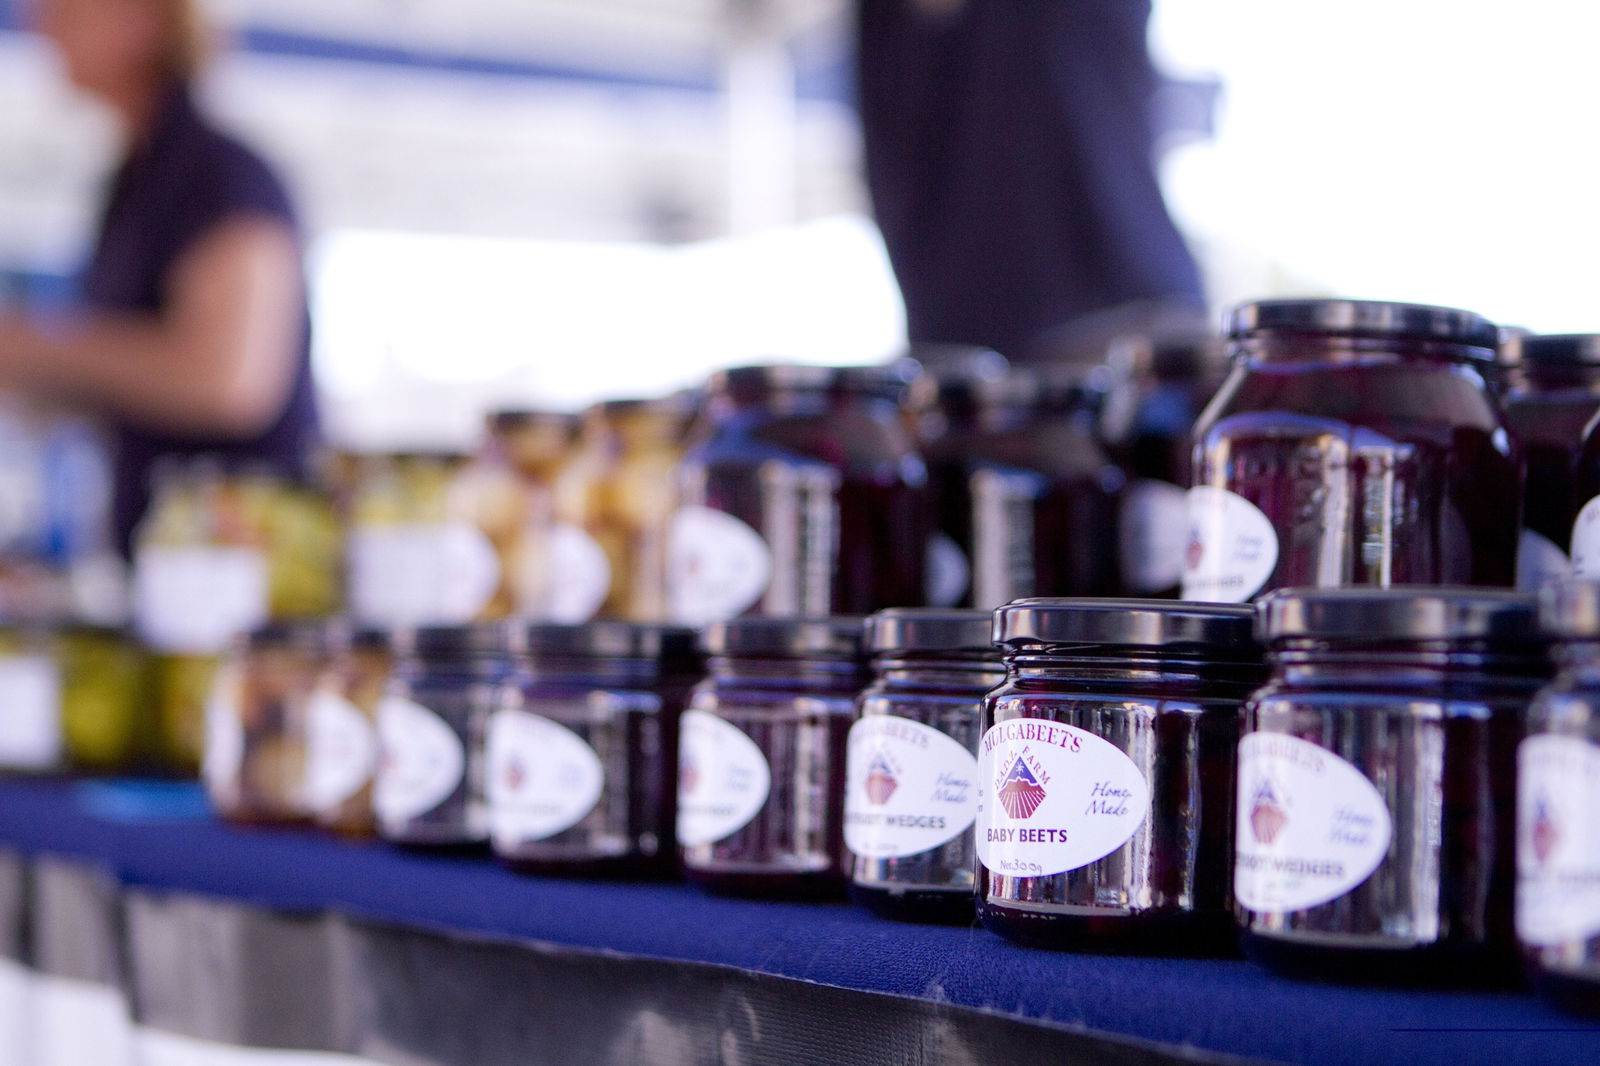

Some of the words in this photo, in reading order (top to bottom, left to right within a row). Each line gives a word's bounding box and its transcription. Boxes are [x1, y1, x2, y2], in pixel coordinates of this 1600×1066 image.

[984, 723, 1083, 756] MULGABEETS
[1022, 745, 1051, 785] FARM
[1090, 780, 1132, 797] Home
[1084, 797, 1128, 816] Made
[886, 814, 945, 829] WEDGES
[987, 828, 1015, 842] BABY
[1019, 828, 1068, 843] BEETS
